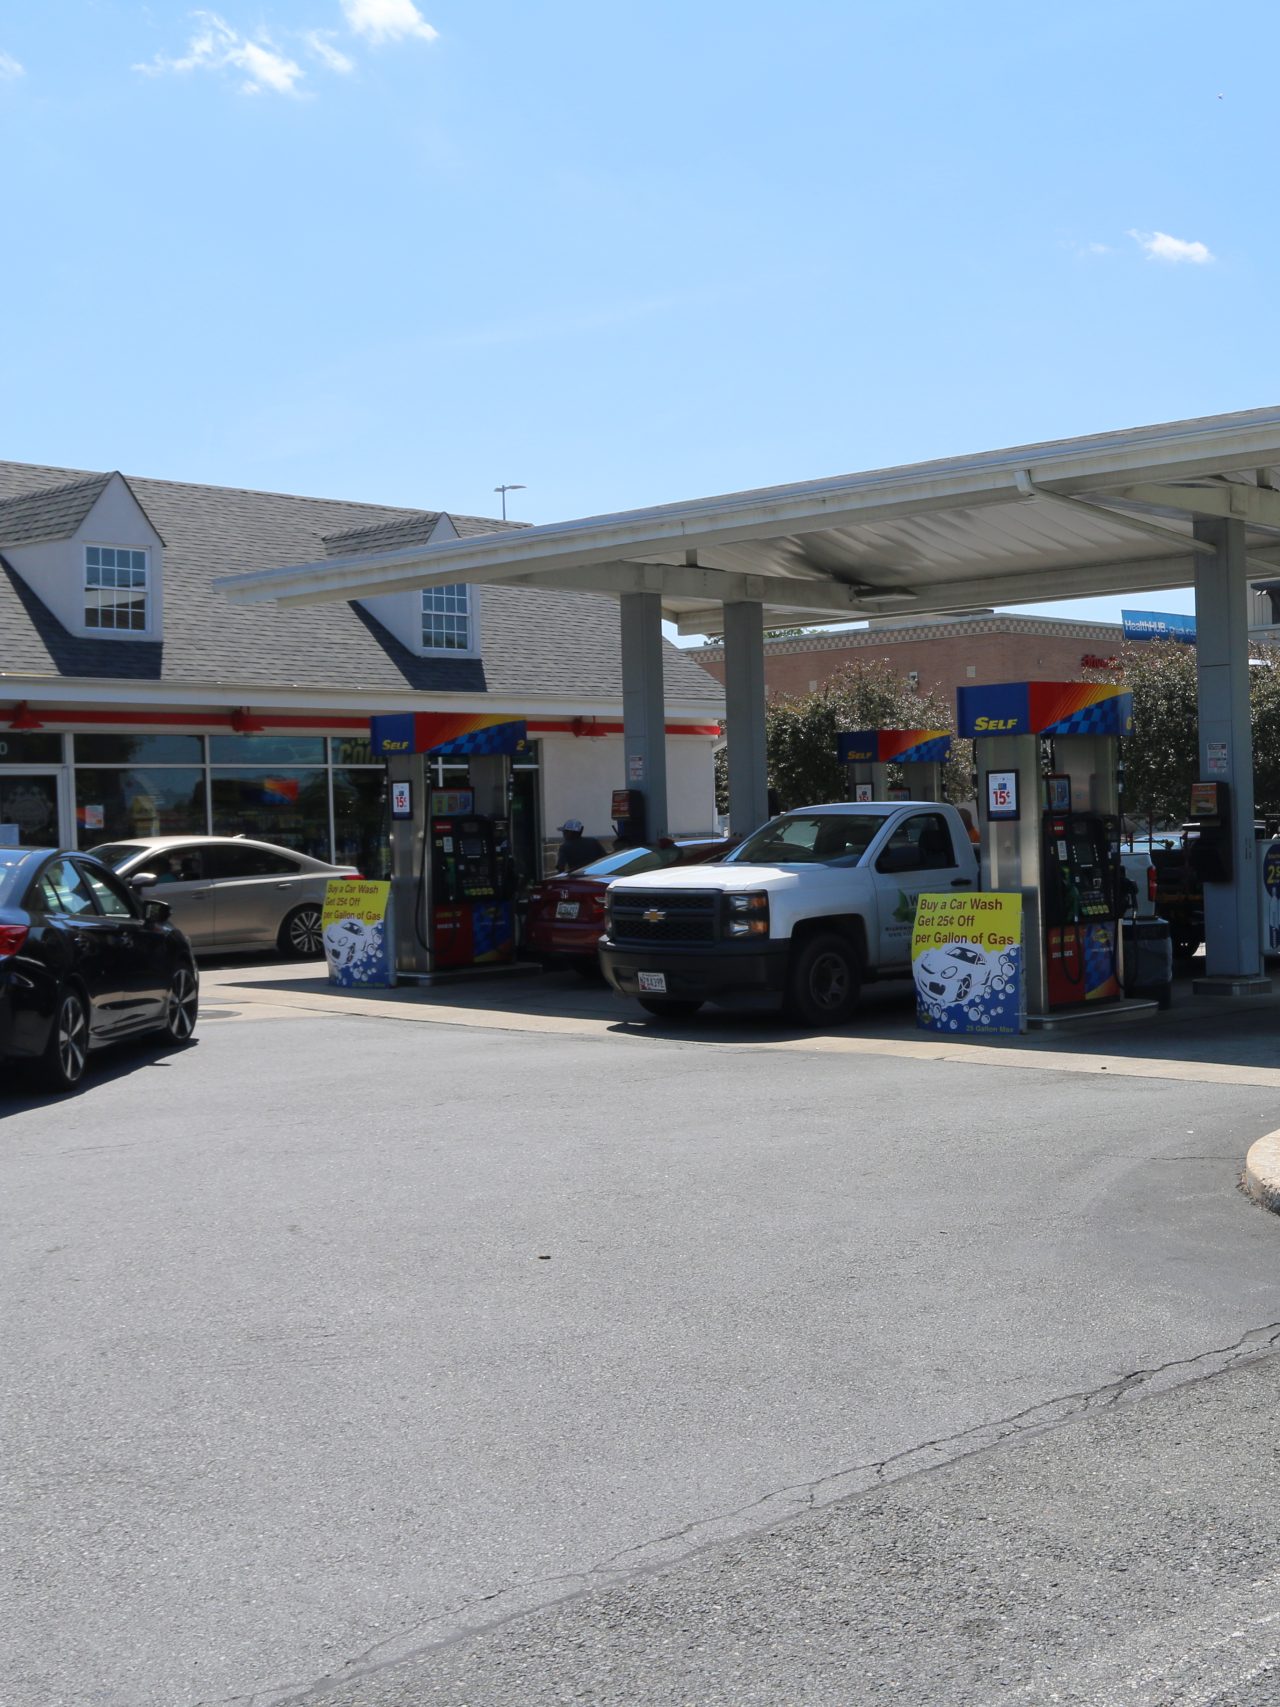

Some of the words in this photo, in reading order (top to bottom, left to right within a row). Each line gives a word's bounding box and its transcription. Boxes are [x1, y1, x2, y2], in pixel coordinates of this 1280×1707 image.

[974, 717, 1018, 731] SELF
[382, 740, 409, 751] SELF
[516, 740, 525, 750] 2
[345, 884, 356, 893] Car
[358, 885, 379, 894] Wash
[920, 899, 938, 911] Buy
[940, 901, 947, 910] a
[950, 899, 967, 910] Car
[970, 898, 1003, 911] Wash
[334, 910, 354, 919] Gallon
[366, 911, 381, 921] Gas
[917, 915, 934, 927] Get
[936, 915, 954, 927] 25¢
[957, 915, 975, 927] Off
[915, 933, 931, 946] per
[934, 932, 967, 944] Gallon
[971, 932, 983, 944] of
[988, 933, 1014, 945] Gas
